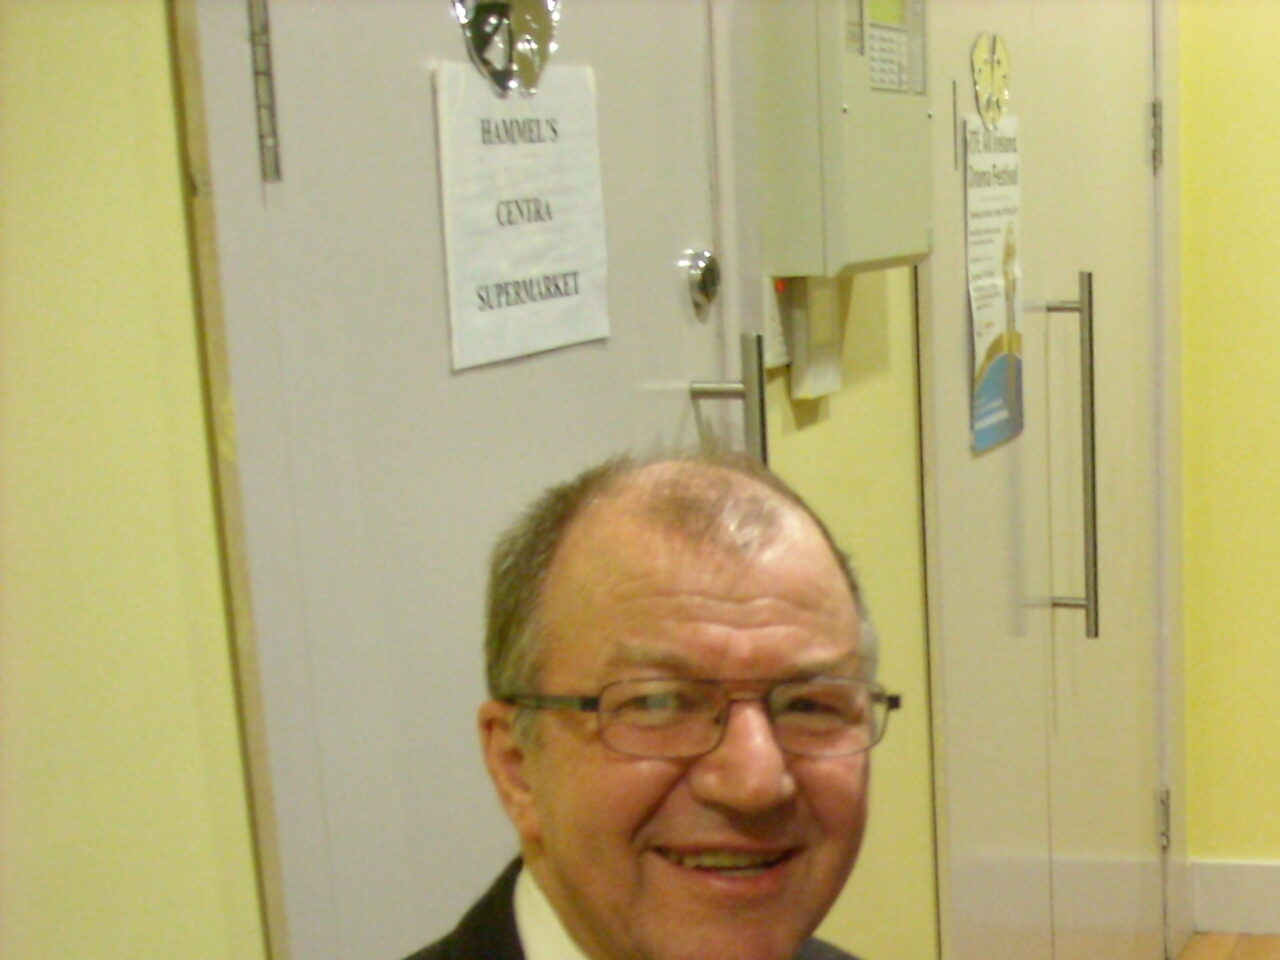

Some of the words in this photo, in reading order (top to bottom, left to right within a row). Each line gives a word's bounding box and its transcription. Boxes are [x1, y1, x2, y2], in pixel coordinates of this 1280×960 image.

[480, 118, 558, 145] HAMMEL'S
[496, 198, 553, 226] CENTRA
[476, 271, 579, 312] SUPERMARKET
